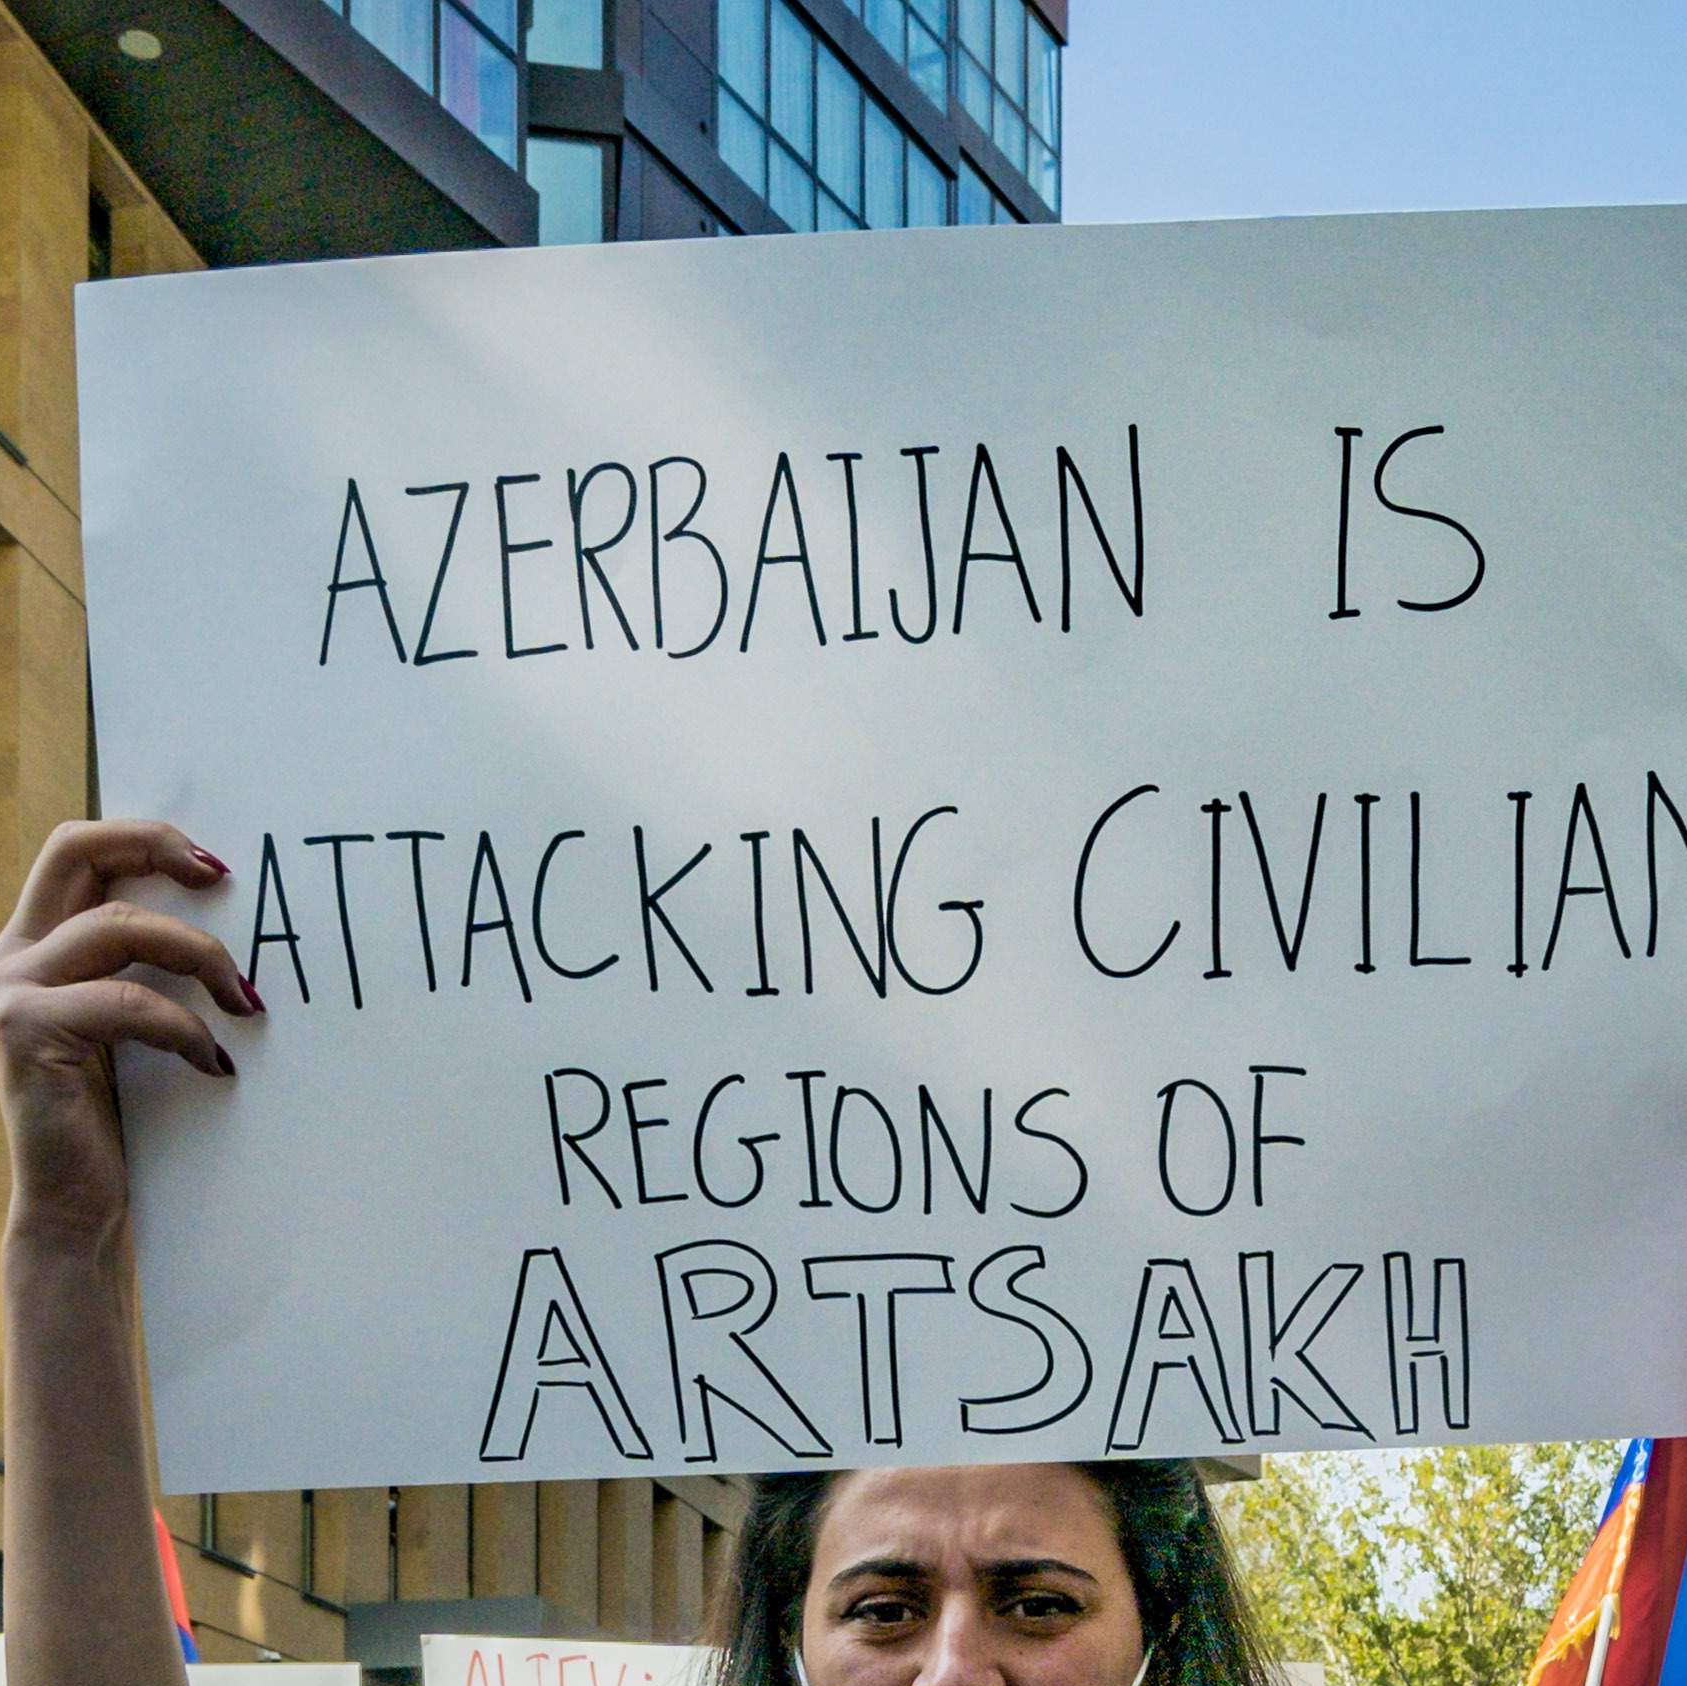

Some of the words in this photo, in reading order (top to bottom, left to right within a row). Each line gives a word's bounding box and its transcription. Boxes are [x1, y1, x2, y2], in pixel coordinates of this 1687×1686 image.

[319, 424, 1144, 667] AZERBAIJAN
[1328, 425, 1485, 620] IS
[247, 806, 984, 1006] ATTACKING
[544, 1067, 1088, 1218] REGIONS
[1157, 1065, 1306, 1217] OF
[479, 1239, 1472, 1463] ARTSAKH
